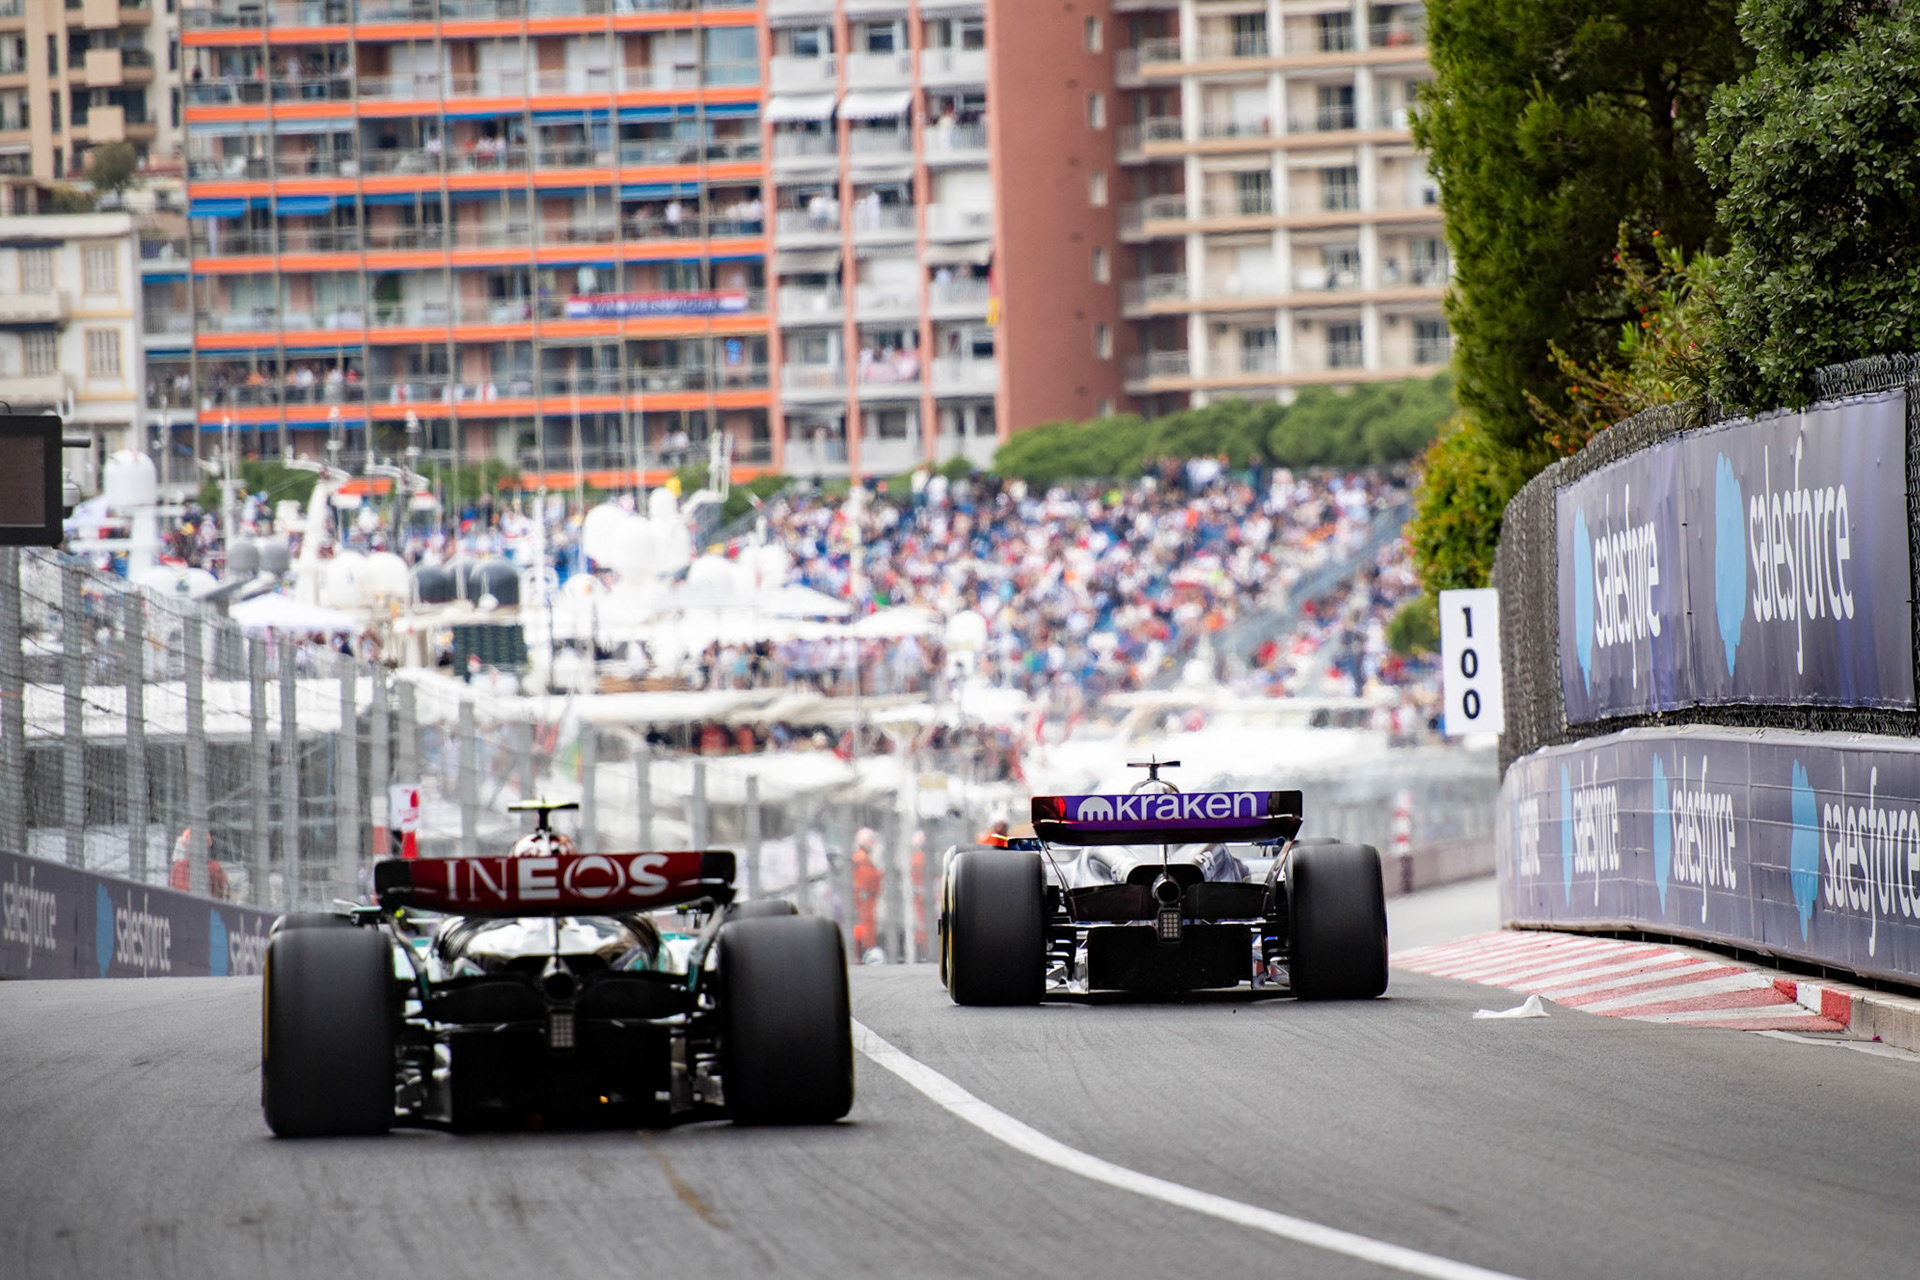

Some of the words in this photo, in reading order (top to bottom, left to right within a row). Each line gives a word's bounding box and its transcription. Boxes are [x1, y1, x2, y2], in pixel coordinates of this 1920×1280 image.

[1748, 436, 1854, 675] salesforce
[1461, 607, 1481, 719] 100
[1117, 792, 1258, 820] kraken
[1573, 755, 1620, 907] salesforce
[1673, 756, 1737, 923] salesforce
[1824, 766, 1920, 957] salesforce
[3, 863, 56, 969] salesforce
[116, 888, 171, 977] salesforce
[444, 854, 670, 901] INEOS
